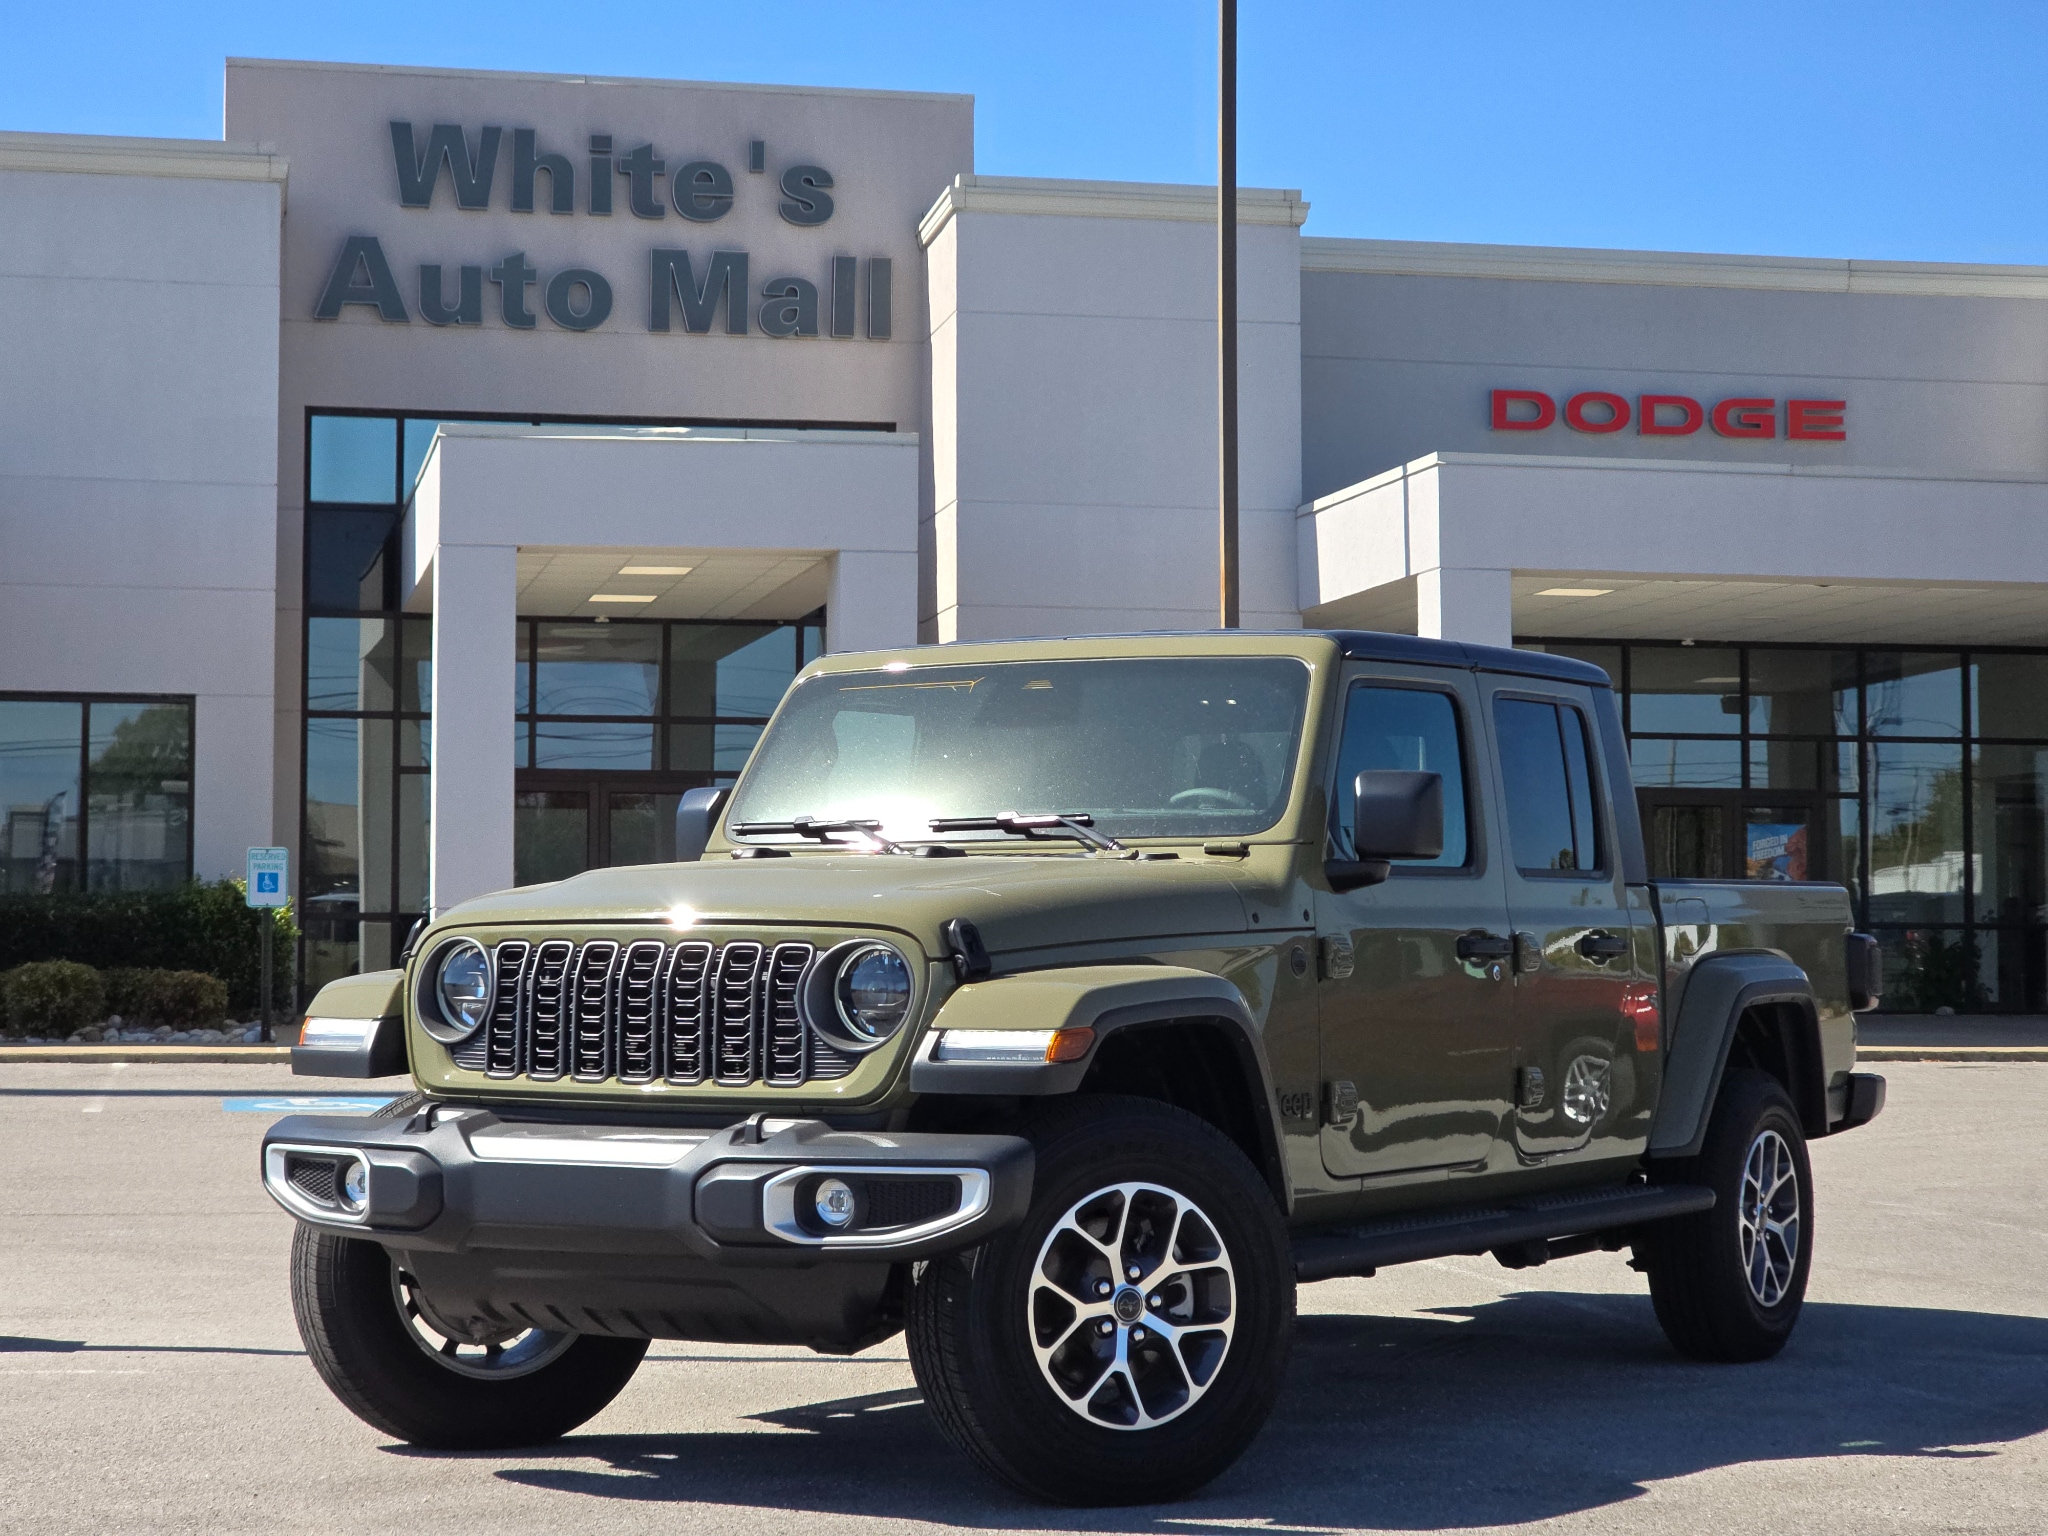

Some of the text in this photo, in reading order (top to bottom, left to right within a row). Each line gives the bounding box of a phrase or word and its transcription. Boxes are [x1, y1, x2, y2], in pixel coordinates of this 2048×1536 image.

[389, 121, 836, 227] White's
[313, 235, 893, 340] Auto Mall
[1491, 388, 1847, 441] DODGE
[251, 852, 286, 861] RESERVED
[1752, 834, 1788, 850] FORGED IN
